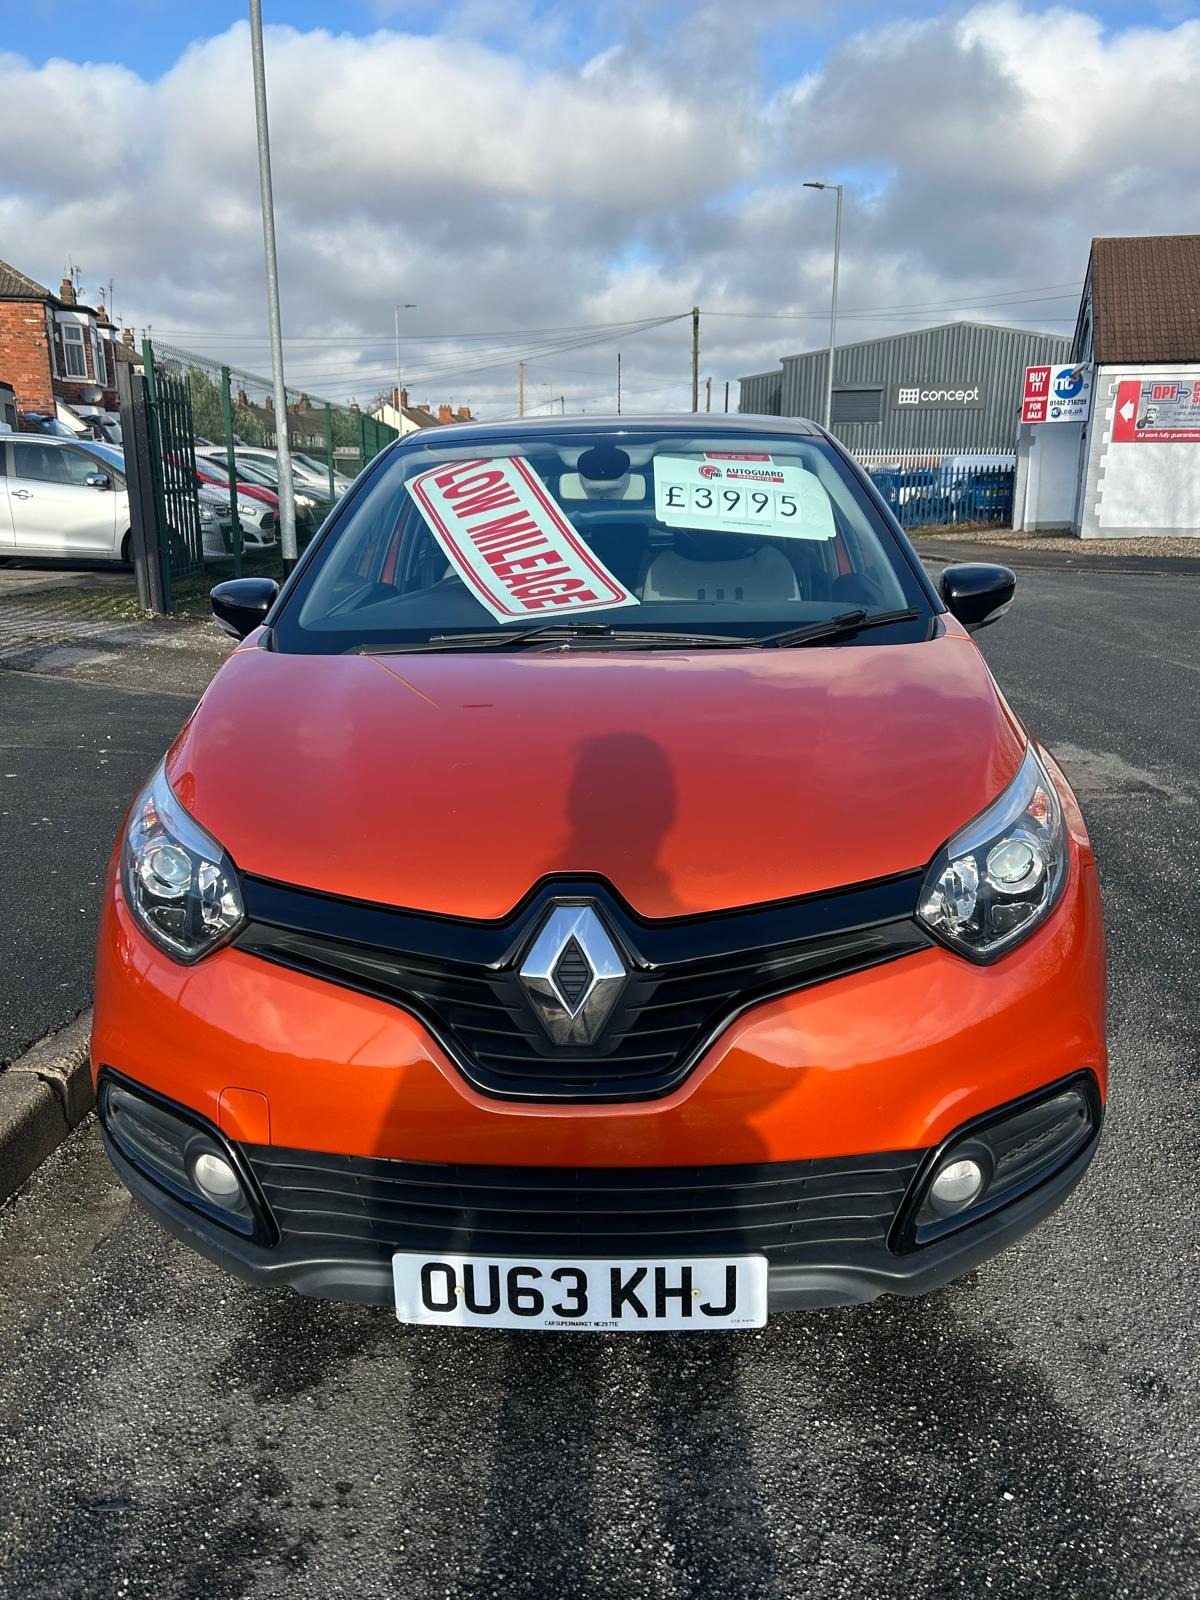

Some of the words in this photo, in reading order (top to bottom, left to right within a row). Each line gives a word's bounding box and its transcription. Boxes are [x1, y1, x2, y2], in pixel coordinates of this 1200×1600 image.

[1029, 371, 1048, 383] BUY
[1031, 382, 1043, 392] IT!
[1153, 386, 1177, 400] DPF
[920, 386, 979, 404] concept
[1029, 403, 1042, 411] FOR
[1026, 411, 1043, 419] SALE
[726, 467, 784, 477] AUTOGUARD
[434, 458, 520, 519] LOW
[665, 486, 797, 516] £3995
[465, 509, 599, 610] MILEAGE
[420, 1262, 588, 1318] OU63
[610, 1265, 737, 1319] KHJ
